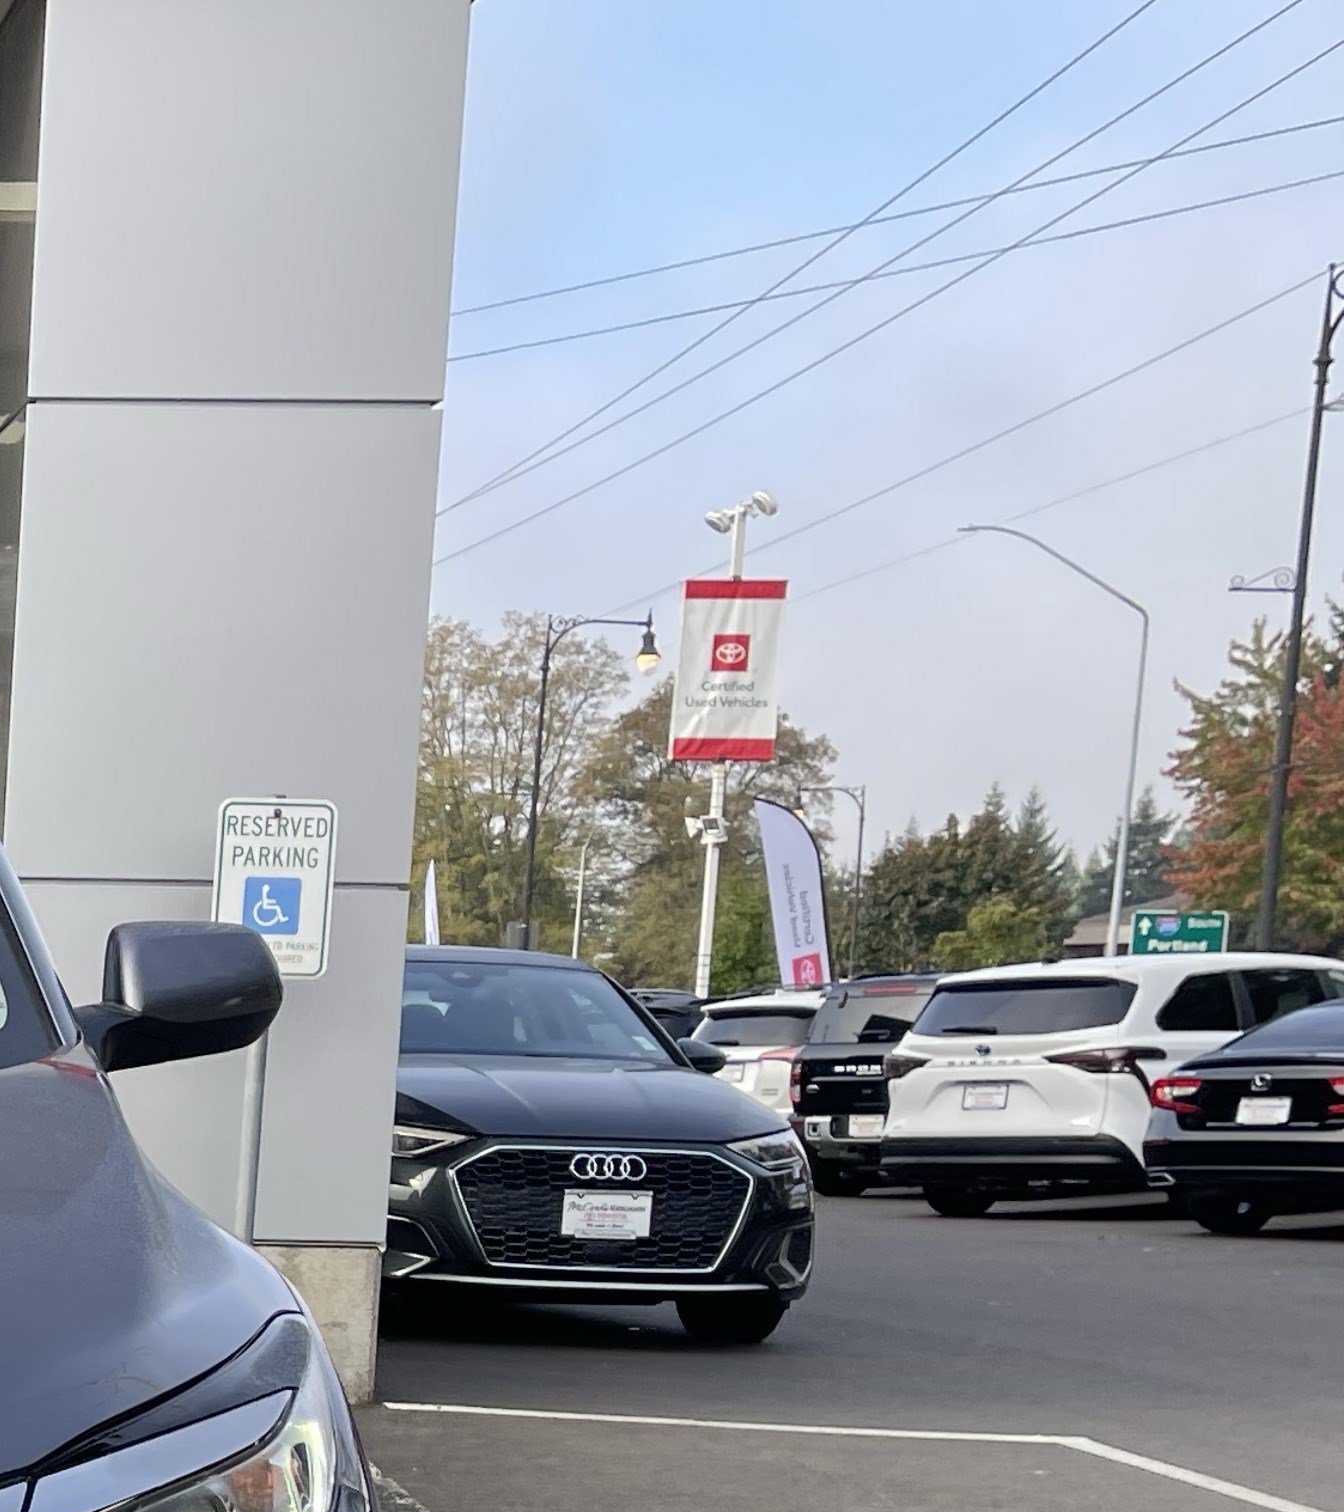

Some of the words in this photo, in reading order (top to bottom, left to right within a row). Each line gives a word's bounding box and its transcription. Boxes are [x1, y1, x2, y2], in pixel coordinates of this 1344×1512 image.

[701, 680, 755, 693] Certified
[685, 697, 717, 708] Used
[720, 696, 768, 708] Vehicles
[226, 814, 329, 838] RESERVED
[232, 845, 319, 868] PARKING
